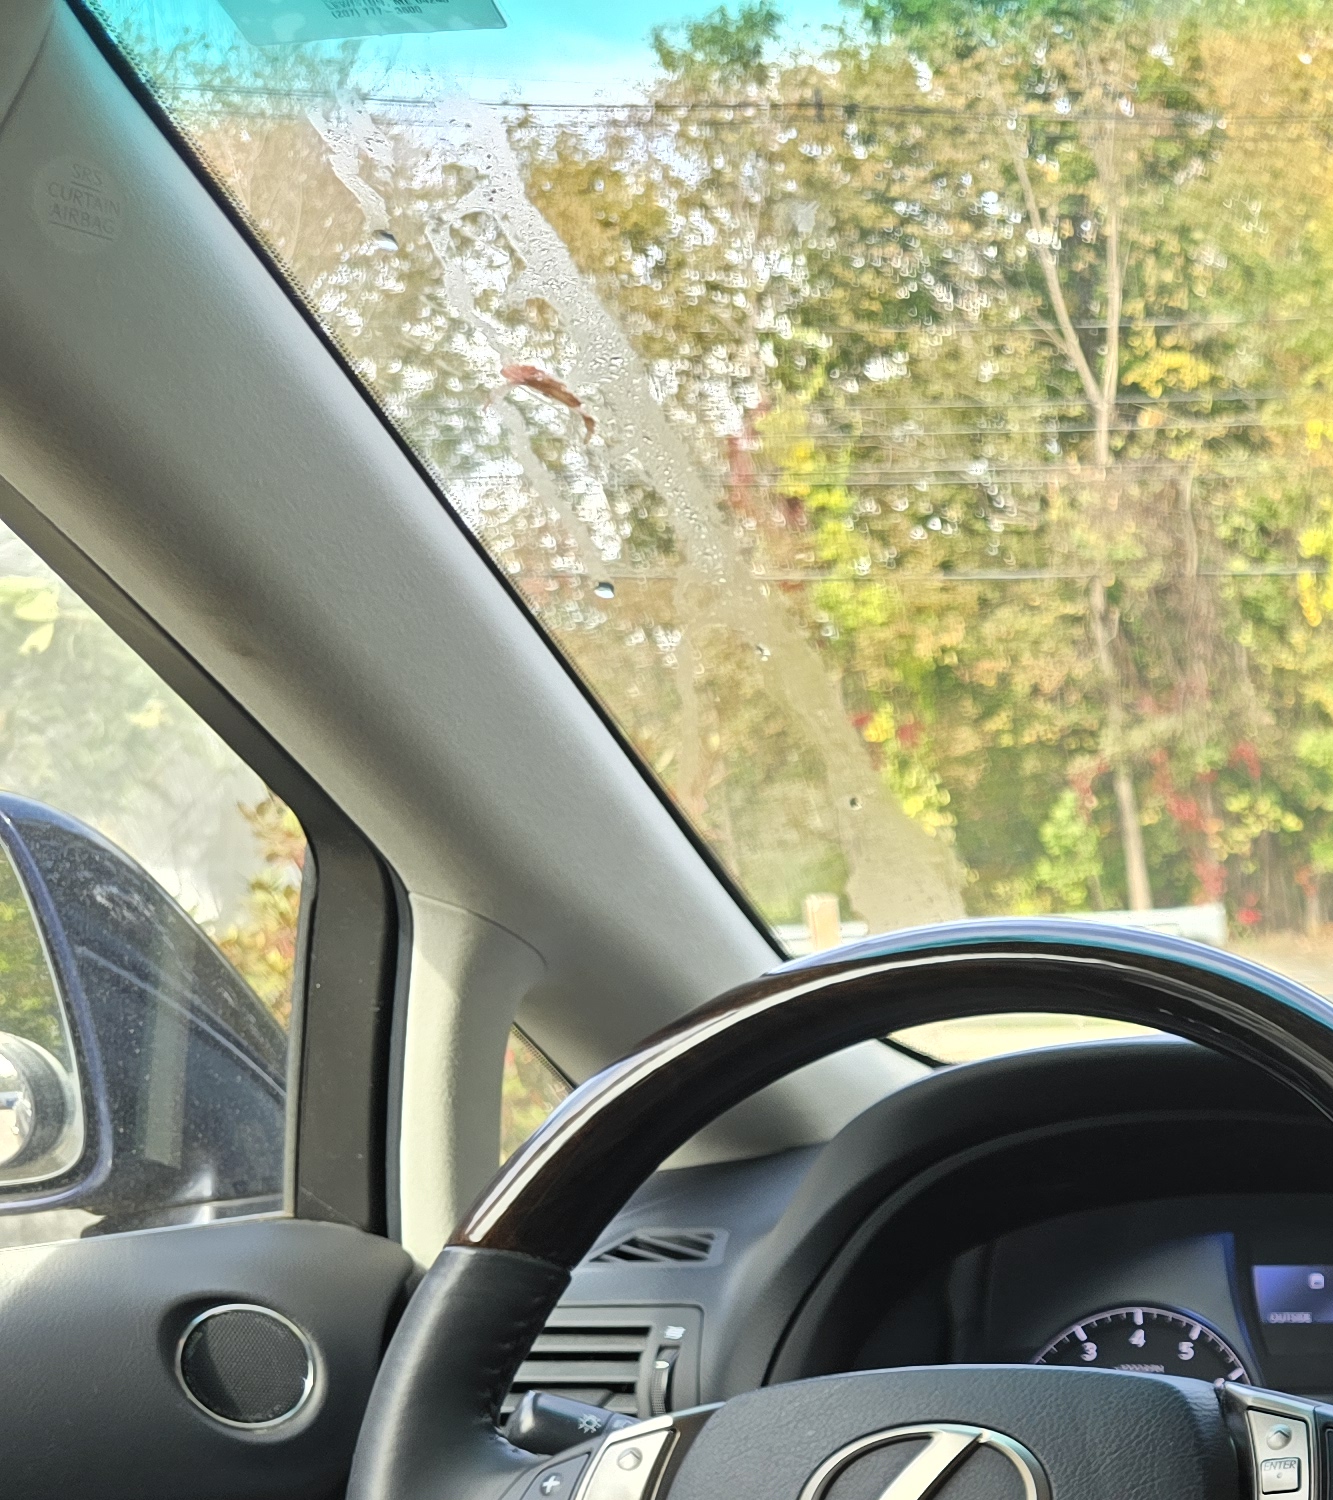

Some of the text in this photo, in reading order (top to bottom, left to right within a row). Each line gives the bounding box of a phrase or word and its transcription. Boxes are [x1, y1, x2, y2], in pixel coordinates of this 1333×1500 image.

[1128, 1328, 1146, 1348] 4
[1080, 1341, 1098, 1362] 3
[1177, 1341, 1195, 1361] 5
[1263, 1459, 1297, 1471] ENTER
